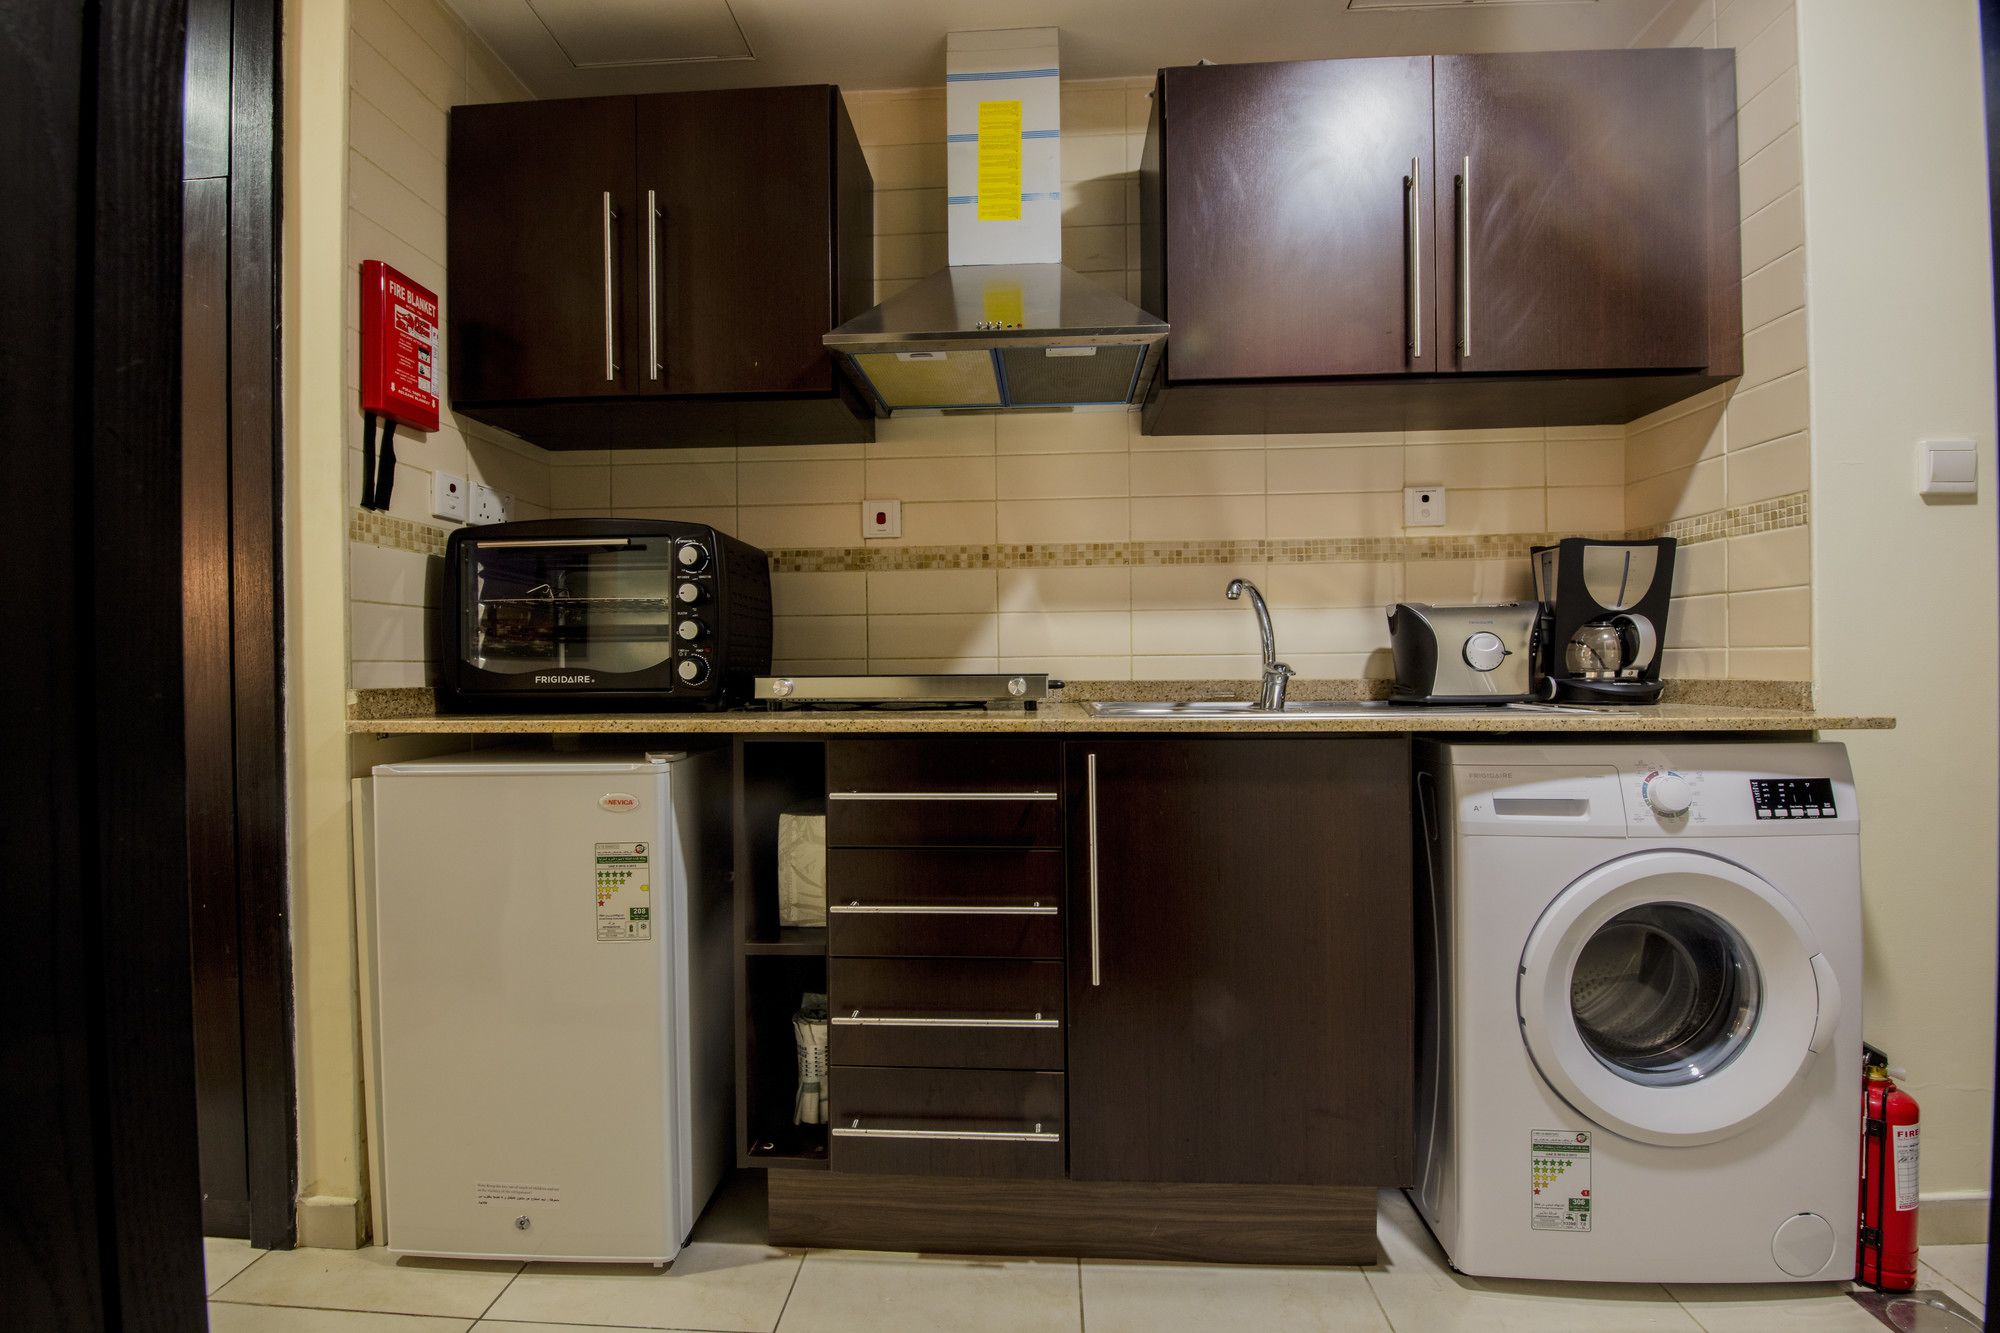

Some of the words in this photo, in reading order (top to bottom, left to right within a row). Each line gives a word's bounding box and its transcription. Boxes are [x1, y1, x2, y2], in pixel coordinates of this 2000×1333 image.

[390, 280, 406, 301] FIRE
[407, 290, 436, 318] BLANKET
[1897, 1128, 1920, 1138] FIRE
